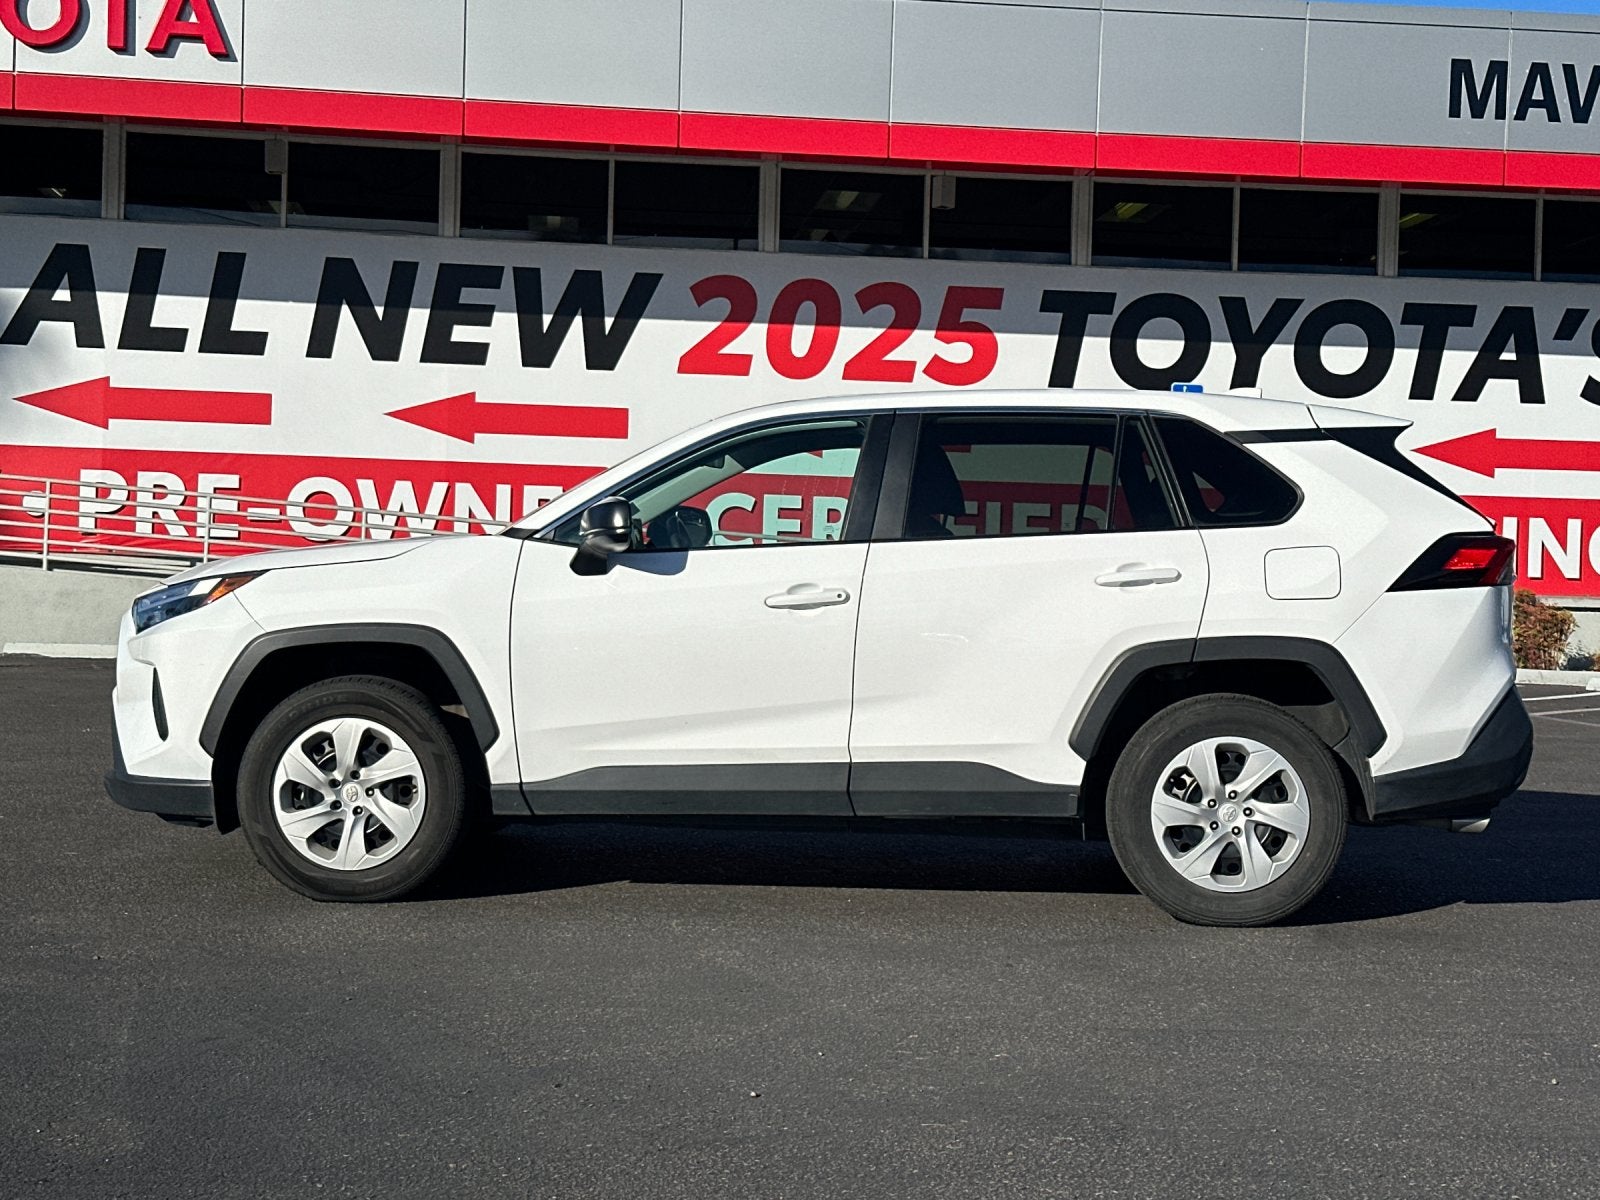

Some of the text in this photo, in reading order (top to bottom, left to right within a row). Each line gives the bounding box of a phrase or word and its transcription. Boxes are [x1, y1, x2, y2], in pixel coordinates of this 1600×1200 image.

[0, 243, 268, 355] ALL
[305, 256, 663, 371] NEW
[677, 274, 1005, 386] 2025
